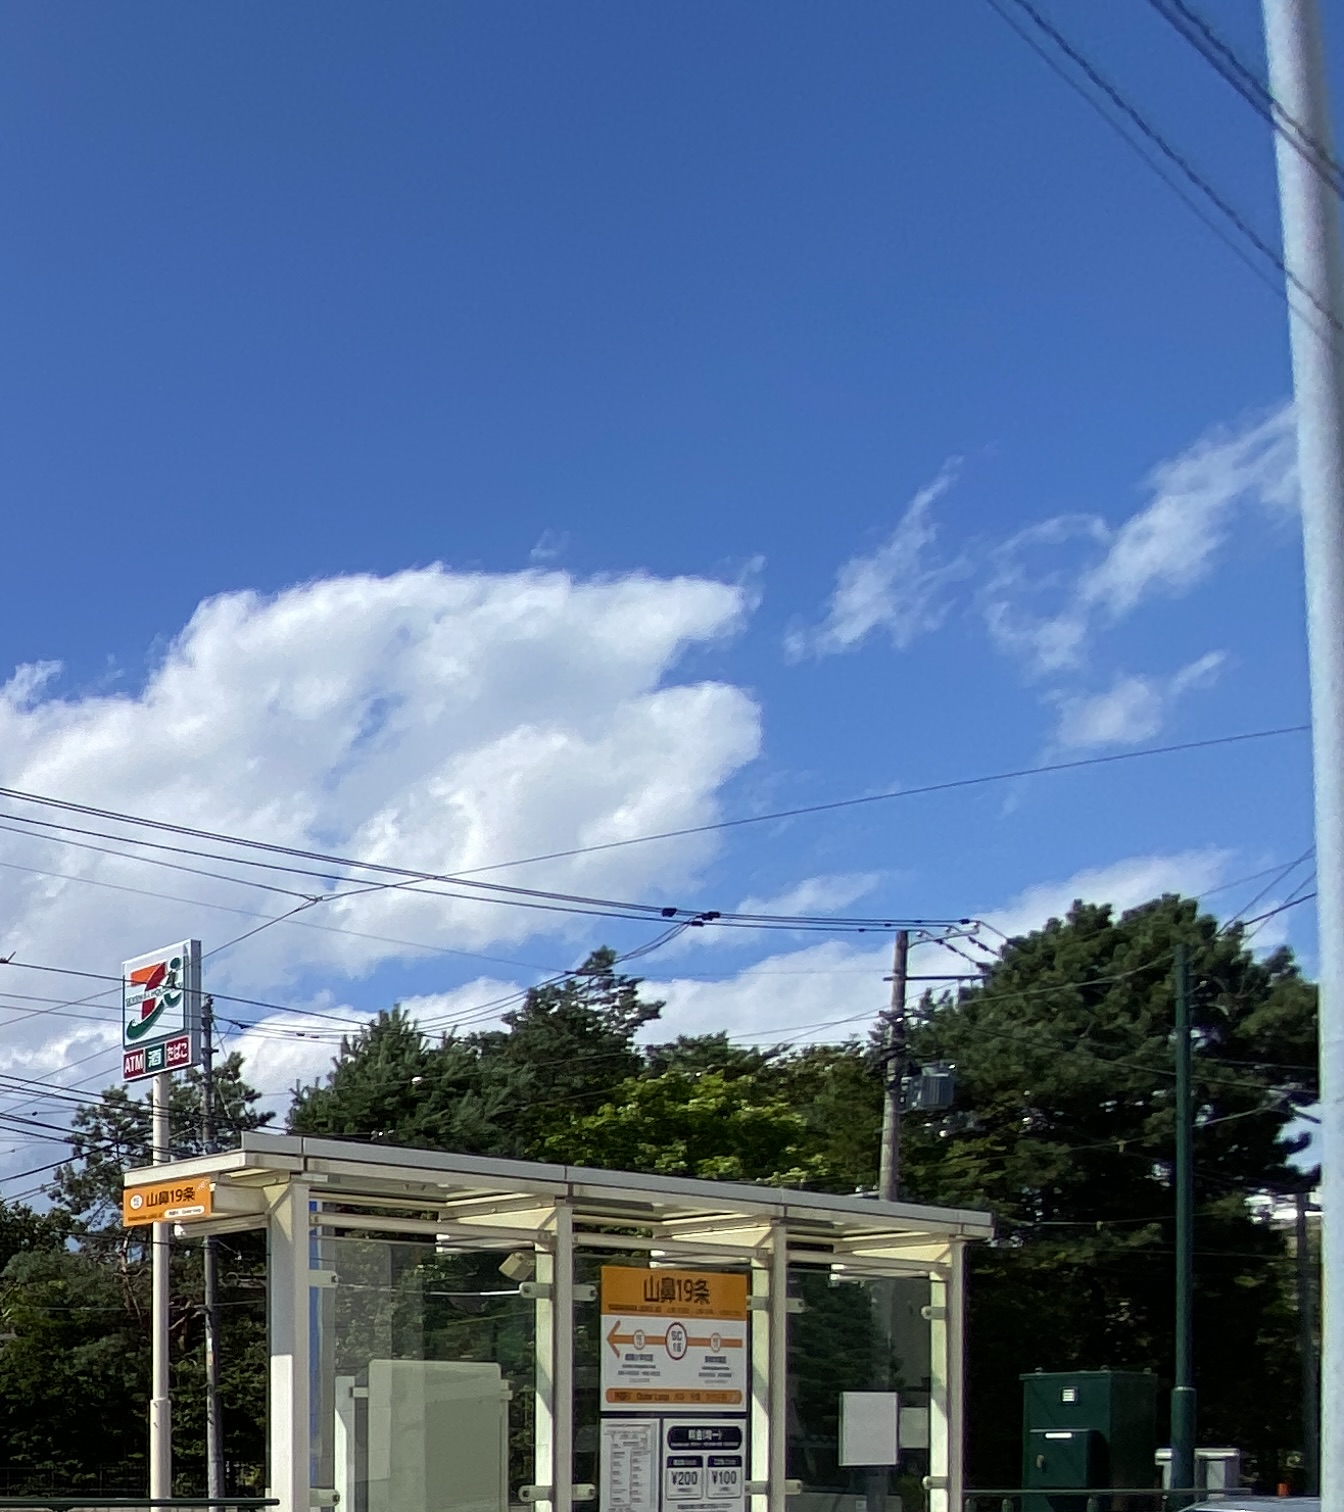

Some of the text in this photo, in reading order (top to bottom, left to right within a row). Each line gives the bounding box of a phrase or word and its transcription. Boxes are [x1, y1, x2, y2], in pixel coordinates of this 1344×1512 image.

[148, 1048, 162, 1068] 酒
[166, 1041, 188, 1062] たばこ
[124, 1053, 144, 1074] ATM
[146, 1186, 196, 1208] 山鼻19条
[644, 1275, 711, 1306] 山鼻19条
